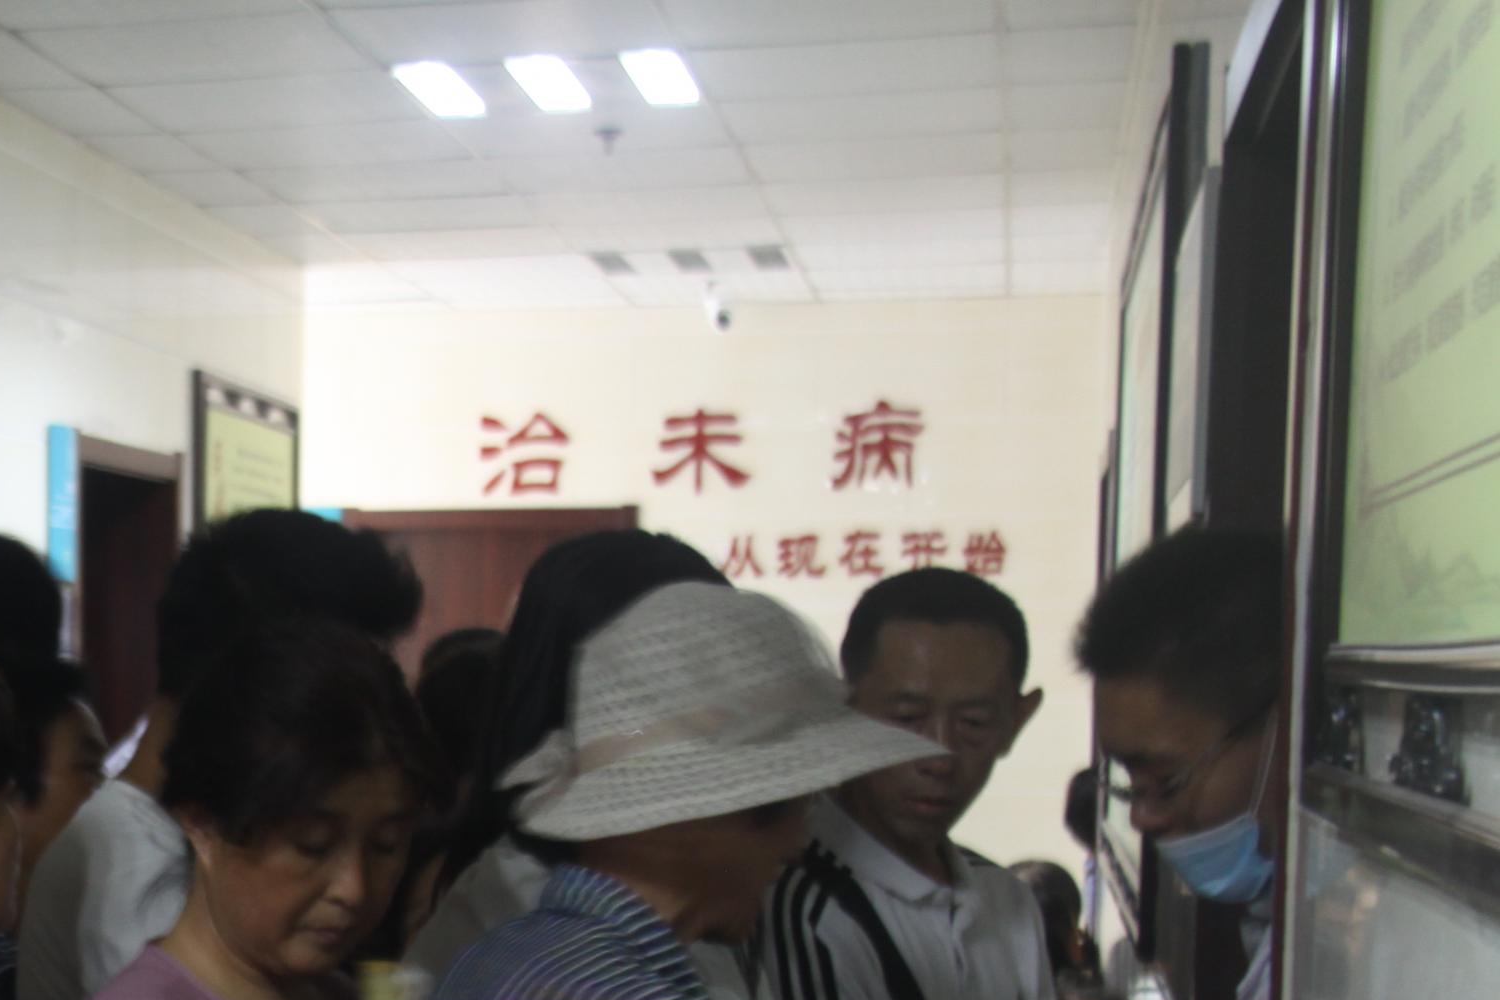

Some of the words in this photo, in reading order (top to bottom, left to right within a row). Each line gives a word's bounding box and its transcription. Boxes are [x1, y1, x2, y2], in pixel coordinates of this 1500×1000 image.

[479, 400, 925, 496] 治未病
[721, 530, 1007, 578] 从现在开始
